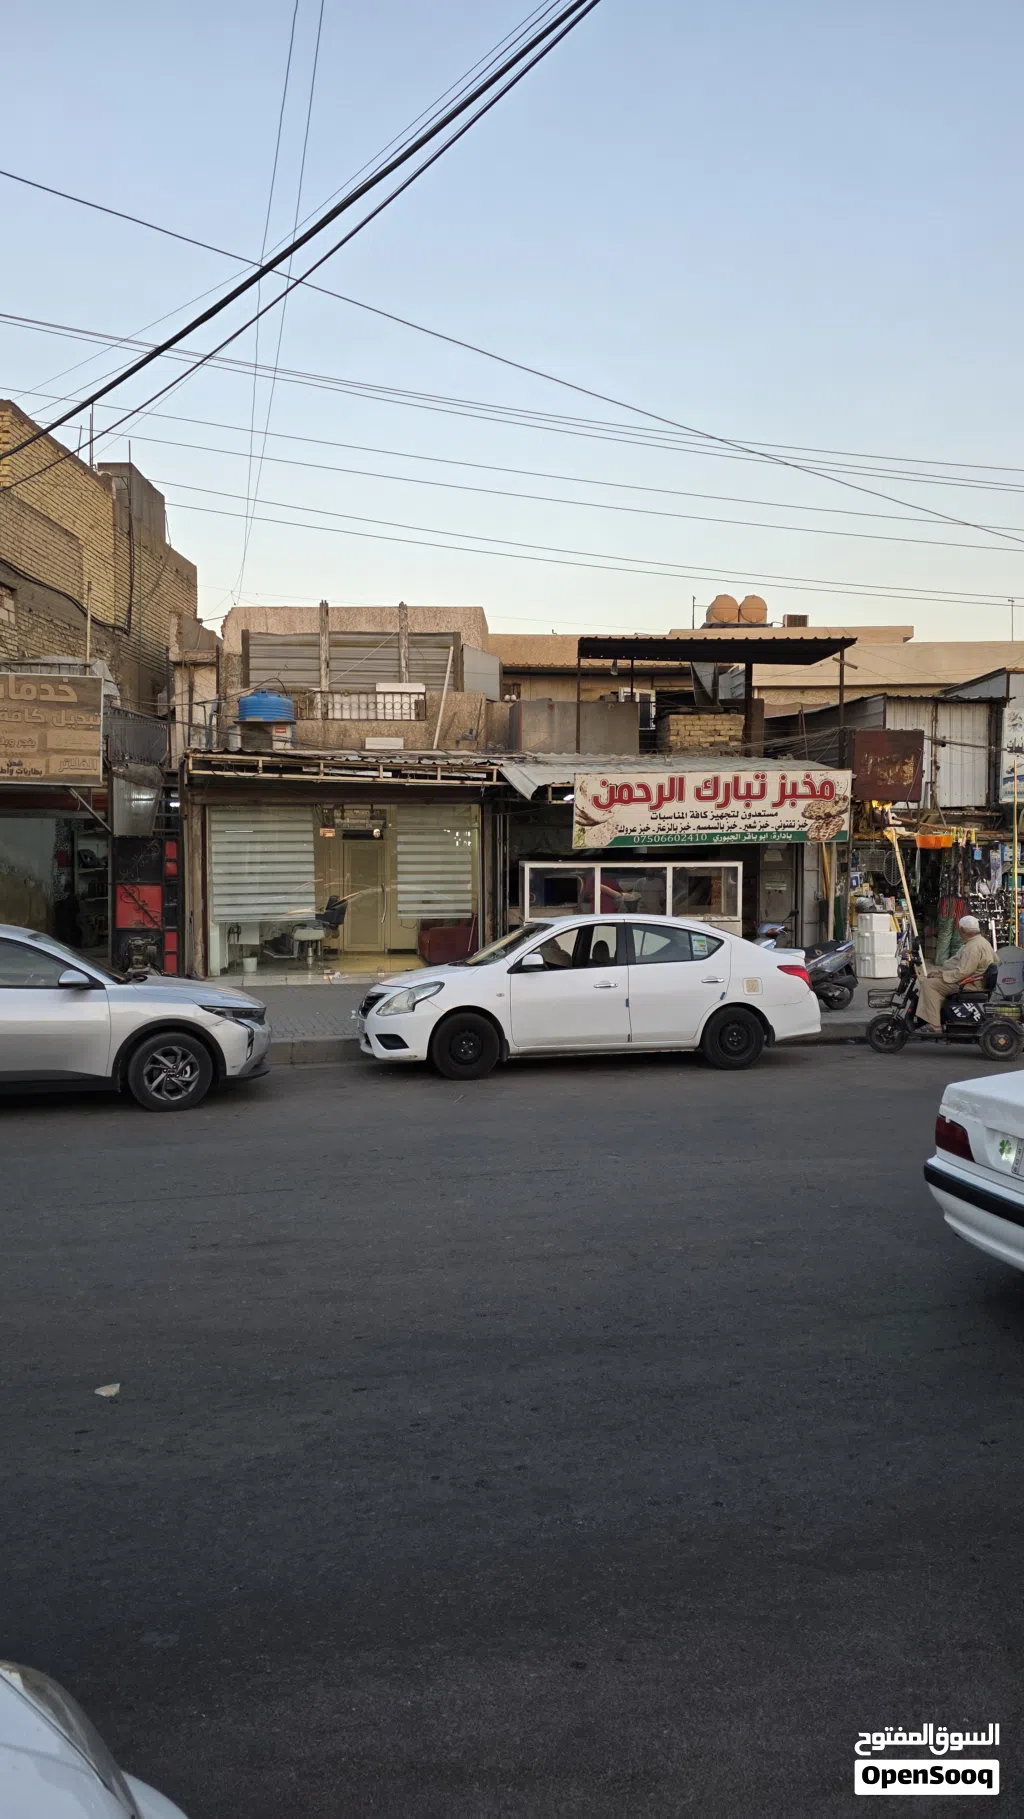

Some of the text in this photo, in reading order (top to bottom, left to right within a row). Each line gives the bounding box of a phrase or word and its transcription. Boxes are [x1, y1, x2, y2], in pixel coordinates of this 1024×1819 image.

[0, 675, 78, 703] خدما
[592, 772, 836, 812] مخبز تبارك الرحمن
[650, 810, 779, 822] مستعدون لتجهيز كافة المناسبات
[639, 824, 651, 834] خبز
[655, 823, 678, 834] بالزعتر
[680, 822, 692, 833] خبز
[696, 821, 725, 833] بالسمسم
[726, 822, 738, 832] خبز
[743, 820, 758, 832] شعير
[758, 821, 770, 832] خبز
[796, 820, 809, 831] خبز
[633, 833, 708, 844] 07506602410
[712, 833, 741, 843] الجبوري
[742, 833, 758, 842] باقر
